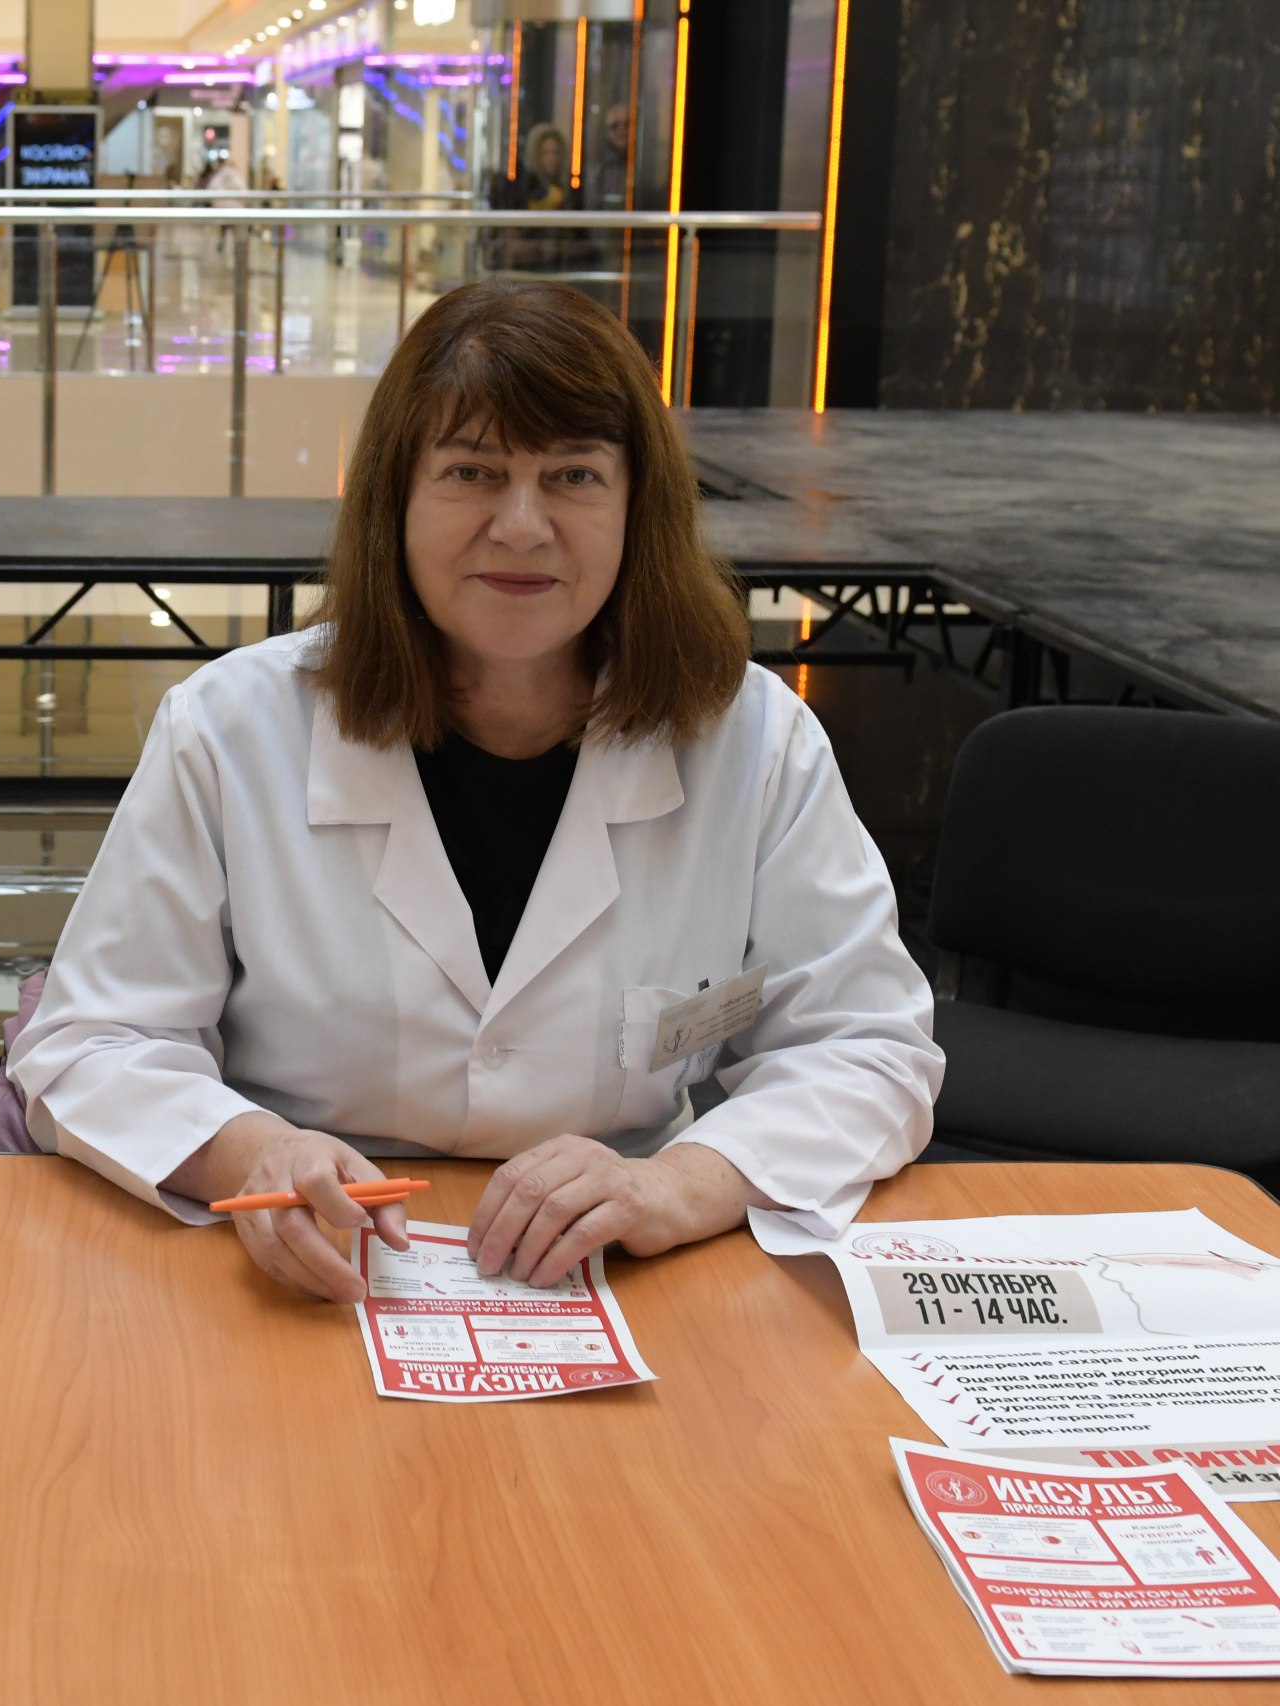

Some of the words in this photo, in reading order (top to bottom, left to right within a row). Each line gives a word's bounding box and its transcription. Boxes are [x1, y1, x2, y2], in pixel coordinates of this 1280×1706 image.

[903, 1272, 938, 1294] 29
[940, 1273, 1058, 1295] ОКТЯБРЯ
[379, 1304, 429, 1313] РИСКА
[407, 1299, 482, 1307] ИНСУЛЬТА
[431, 1304, 503, 1313] ФАКТОРЫ
[485, 1300, 561, 1308] РАЗВИТИЯ
[508, 1305, 593, 1314] ОСНОВНЫЕ
[915, 1298, 946, 1325] 11
[971, 1298, 1004, 1325] 14
[1006, 1298, 1068, 1325] ЧАС.
[934, 1351, 1042, 1361] Измерение
[1048, 1344, 1188, 1355] артериального
[399, 1361, 465, 1374] ПОМОЩЬ
[479, 1364, 559, 1374] ПРИЗНАКИ
[944, 1359, 1053, 1371] Измерение
[1058, 1356, 1123, 1367] сахара
[1142, 1353, 1200, 1364] крови
[956, 1375, 1030, 1385] Оценка
[1034, 1370, 1107, 1382] мелкой
[1111, 1367, 1206, 1379] моторики
[1209, 1365, 1266, 1374] кисти
[400, 1373, 565, 1393] ИНСУЛЬТ
[964, 1385, 988, 1393] на
[990, 1381, 1099, 1393] тренажере
[975, 1393, 1102, 1404] Диагностика
[1106, 1388, 1268, 1400] эмоционального
[1001, 1403, 1070, 1412] уровня
[1076, 1400, 1152, 1410] стресса
[1172, 1397, 1266, 1406] помощью
[991, 1413, 1136, 1425] Врач-терапевт
[1003, 1424, 1152, 1437] Врач-невролог
[1153, 1445, 1280, 1468] Сити
[987, 1475, 1174, 1505] ИНСУЛЬТ
[1001, 1501, 1091, 1516] ПРИЗНАКИ
[1105, 1503, 1183, 1517] ПОМОЩЬ
[987, 1585, 1094, 1600] ОСНОВНЫЕ
[1098, 1588, 1190, 1600] ФАКТОРЫ
[1193, 1585, 1257, 1597] РИСКА
[1029, 1597, 1127, 1609] РАЗВИТИЯ
[1129, 1597, 1226, 1609] ИНСУЛЬТА
